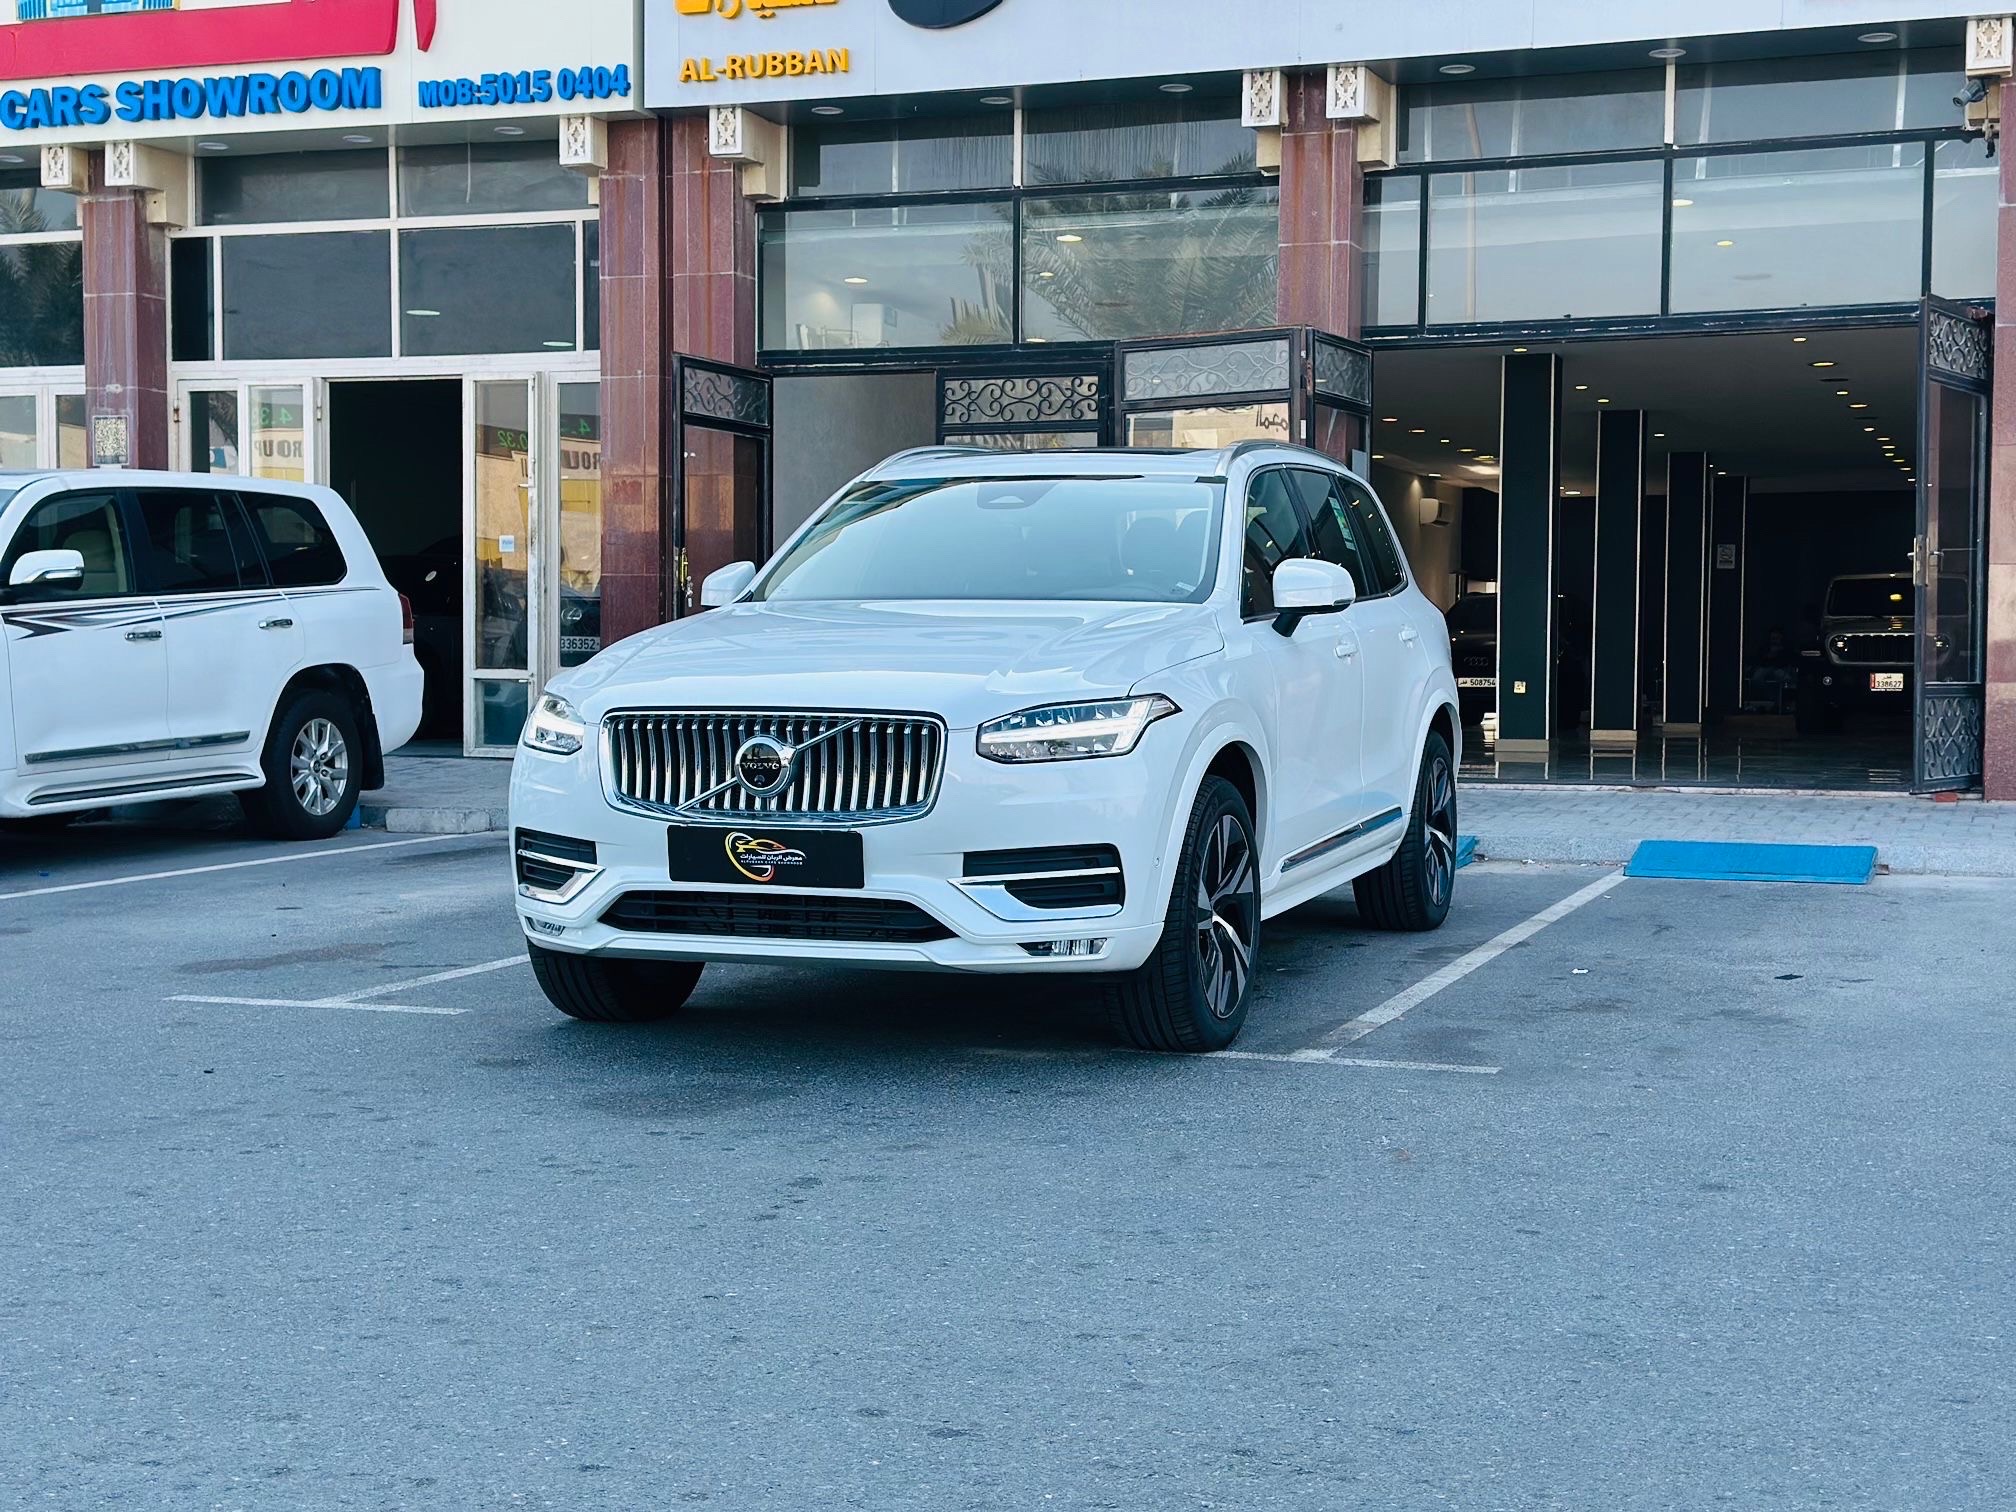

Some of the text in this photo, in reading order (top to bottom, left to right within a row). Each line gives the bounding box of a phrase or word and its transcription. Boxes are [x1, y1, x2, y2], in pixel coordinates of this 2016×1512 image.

[557, 64, 631, 100] 0404
[679, 48, 849, 82] AL-RUBBAN
[0, 67, 381, 130] CARS SHOWROOM
[741, 762, 780, 770] VOLVO
